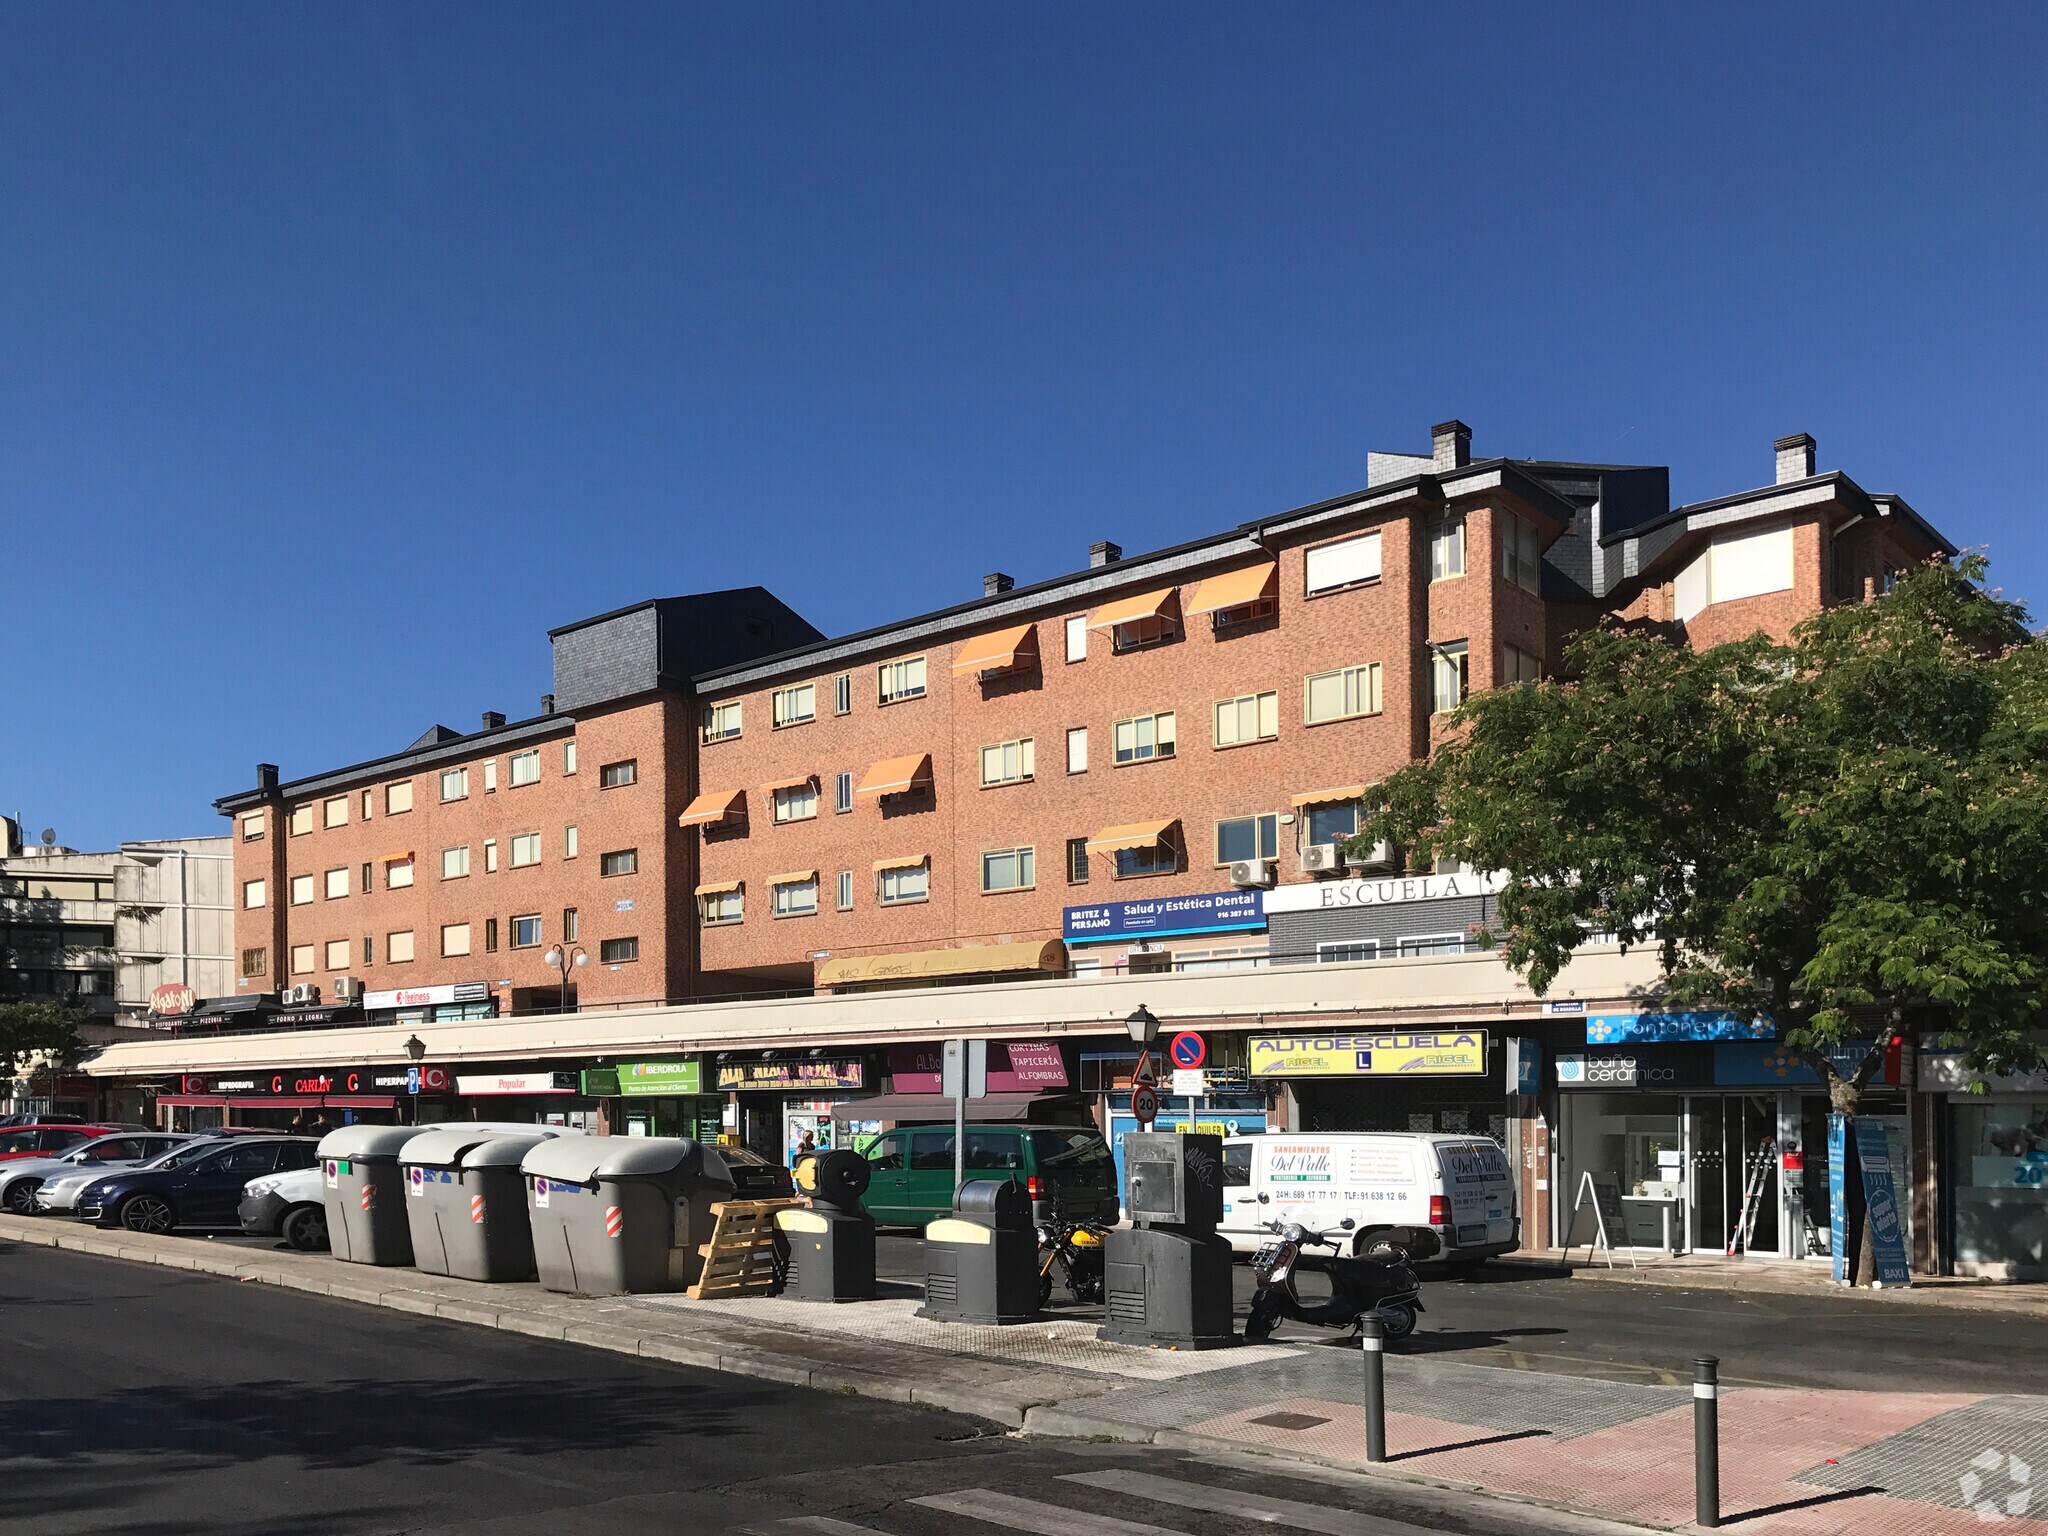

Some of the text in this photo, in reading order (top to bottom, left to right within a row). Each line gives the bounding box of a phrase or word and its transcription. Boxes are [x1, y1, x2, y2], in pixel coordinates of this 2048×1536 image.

[1320, 876, 1463, 907] ESCUELA
[1124, 893, 1255, 915] Salud y Estética Dental
[1071, 908, 1110, 920] BRITEZ &
[1217, 911, 1229, 919] 916
[1071, 919, 1111, 930] PERSANO
[276, 1014, 296, 1023] FORNO
[1008, 1043, 1050, 1053] CORTINAS
[1255, 1035, 1477, 1052] AUTOESCUELA
[1012, 1054, 1060, 1066] TAPICERÍA
[1286, 1058, 1329, 1067] RIGEL
[1358, 1053, 1369, 1068] L
[1426, 1054, 1474, 1064] RIGEL
[1588, 1053, 1636, 1069] baño
[646, 1063, 687, 1075] IBERDROLA
[1588, 1066, 1675, 1081] cerámica
[410, 1071, 416, 1091] P
[426, 1069, 444, 1087] C
[1018, 1071, 1064, 1080] ALFOMBRAS
[218, 1081, 255, 1089] REPROGRAFIA
[498, 1078, 526, 1090] Popular
[1139, 1098, 1154, 1111] 20
[1178, 1125, 1188, 1134] EN
[1273, 1146, 1330, 1154] SANEAMIENTOS
[1270, 1155, 1331, 1171] Del Valle
[1276, 1190, 1292, 1199] 24H:
[1293, 1190, 1305, 1199] 689
[1308, 1190, 1315, 1199] 17
[1318, 1190, 1326, 1200] 77
[1329, 1190, 1337, 1200] 17
[1370, 1192, 1384, 1200] 638
[1387, 1192, 1395, 1200] 12
[1397, 1192, 1407, 1201] 66
[1883, 1268, 1905, 1279] BAXI
